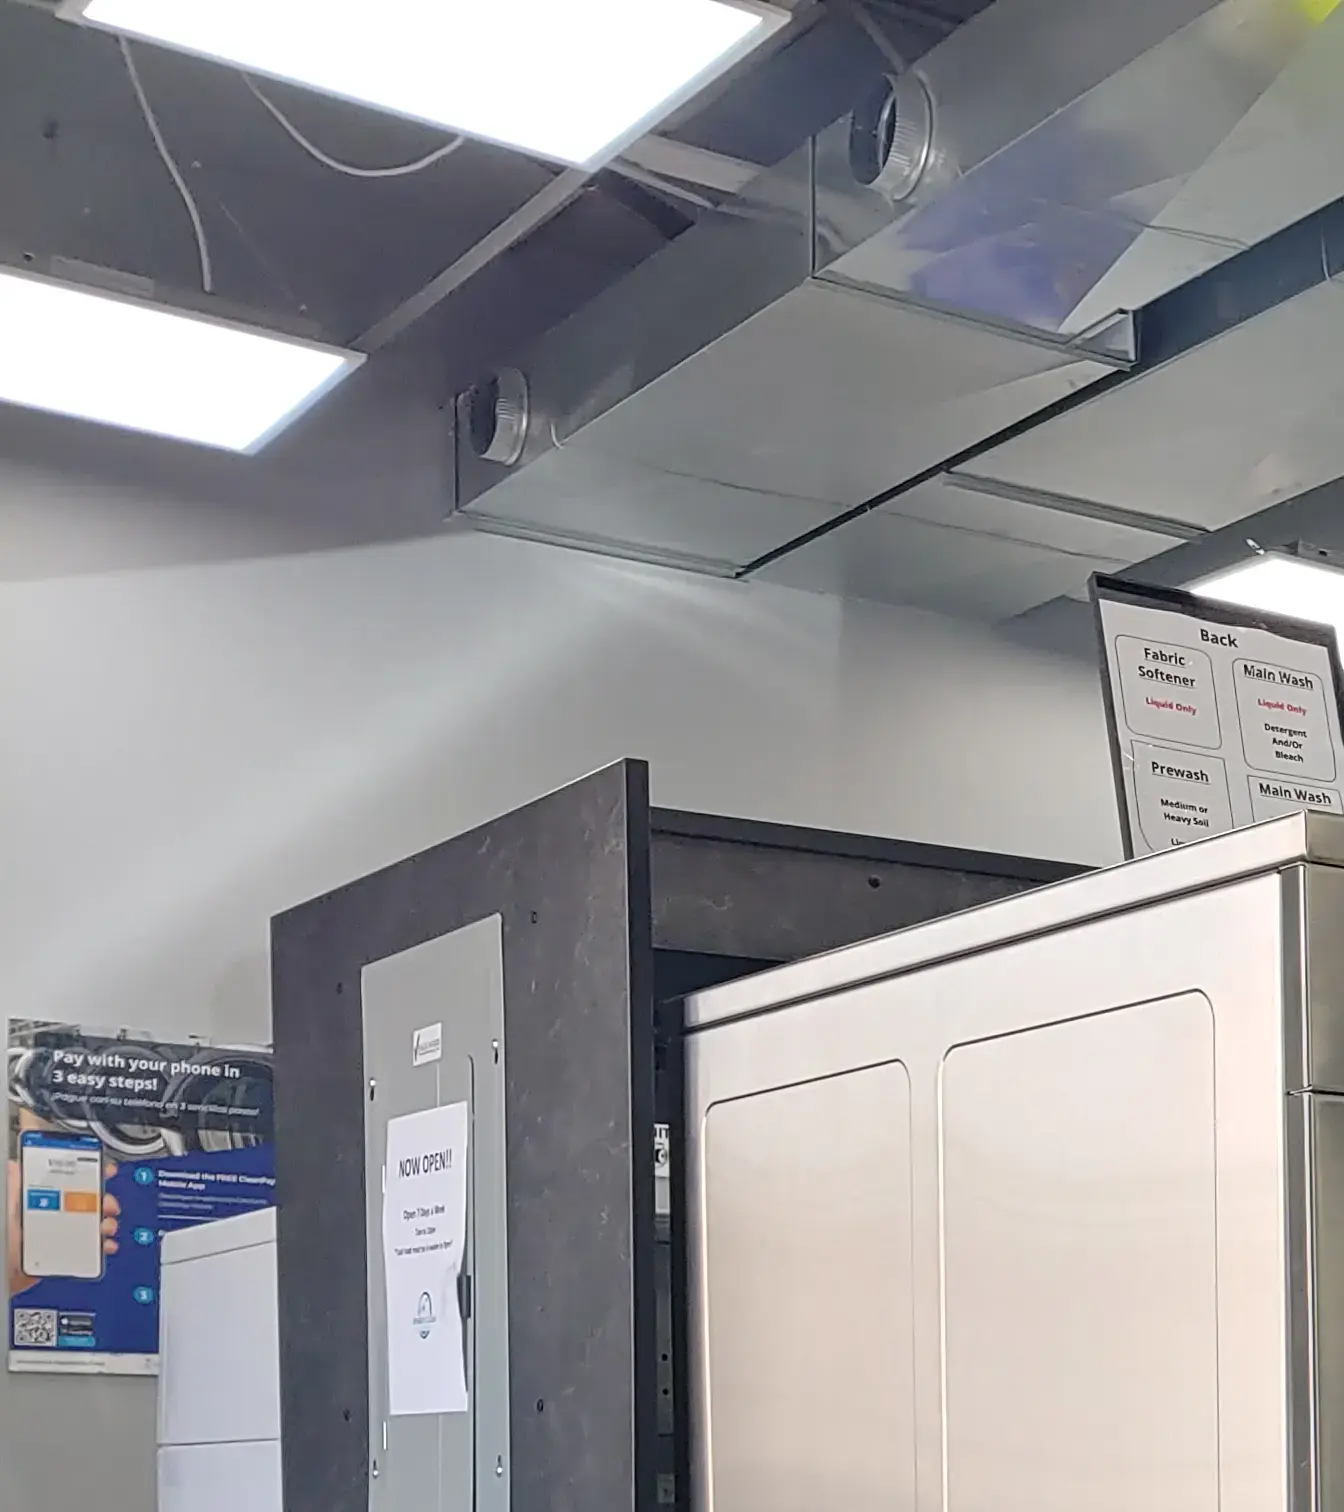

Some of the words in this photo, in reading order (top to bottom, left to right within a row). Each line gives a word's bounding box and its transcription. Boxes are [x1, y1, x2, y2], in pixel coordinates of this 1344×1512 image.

[1200, 628, 1239, 649] Back
[1144, 648, 1185, 667] Fabric
[1138, 665, 1196, 687] Softener
[1243, 664, 1276, 683] Main
[1278, 671, 1314, 690] Wash
[1145, 697, 1174, 711] Liquid
[1175, 703, 1197, 716] Only
[1257, 698, 1284, 711] Liquid
[1286, 704, 1308, 717] Only
[1264, 723, 1308, 739] Detergent
[1272, 737, 1303, 750] And/Or
[1275, 750, 1304, 763] Bleach
[1151, 761, 1209, 783] Prewash
[1259, 782, 1292, 800] Main
[1294, 788, 1331, 805] Wash
[1160, 798, 1197, 813] Medium
[1199, 806, 1208, 814] or
[1163, 812, 1191, 826] Heavy
[1193, 817, 1209, 828] Soil
[53, 1051, 84, 1067] Pay
[87, 1053, 125, 1069] with
[128, 1058, 167, 1073] your
[170, 1061, 222, 1077] phone
[224, 1064, 240, 1078] in
[52, 1070, 64, 1083] 3
[67, 1073, 105, 1089] easy
[108, 1076, 157, 1093] steps!
[399, 1156, 421, 1178] NOW
[422, 1149, 452, 1174] OPEN!!
